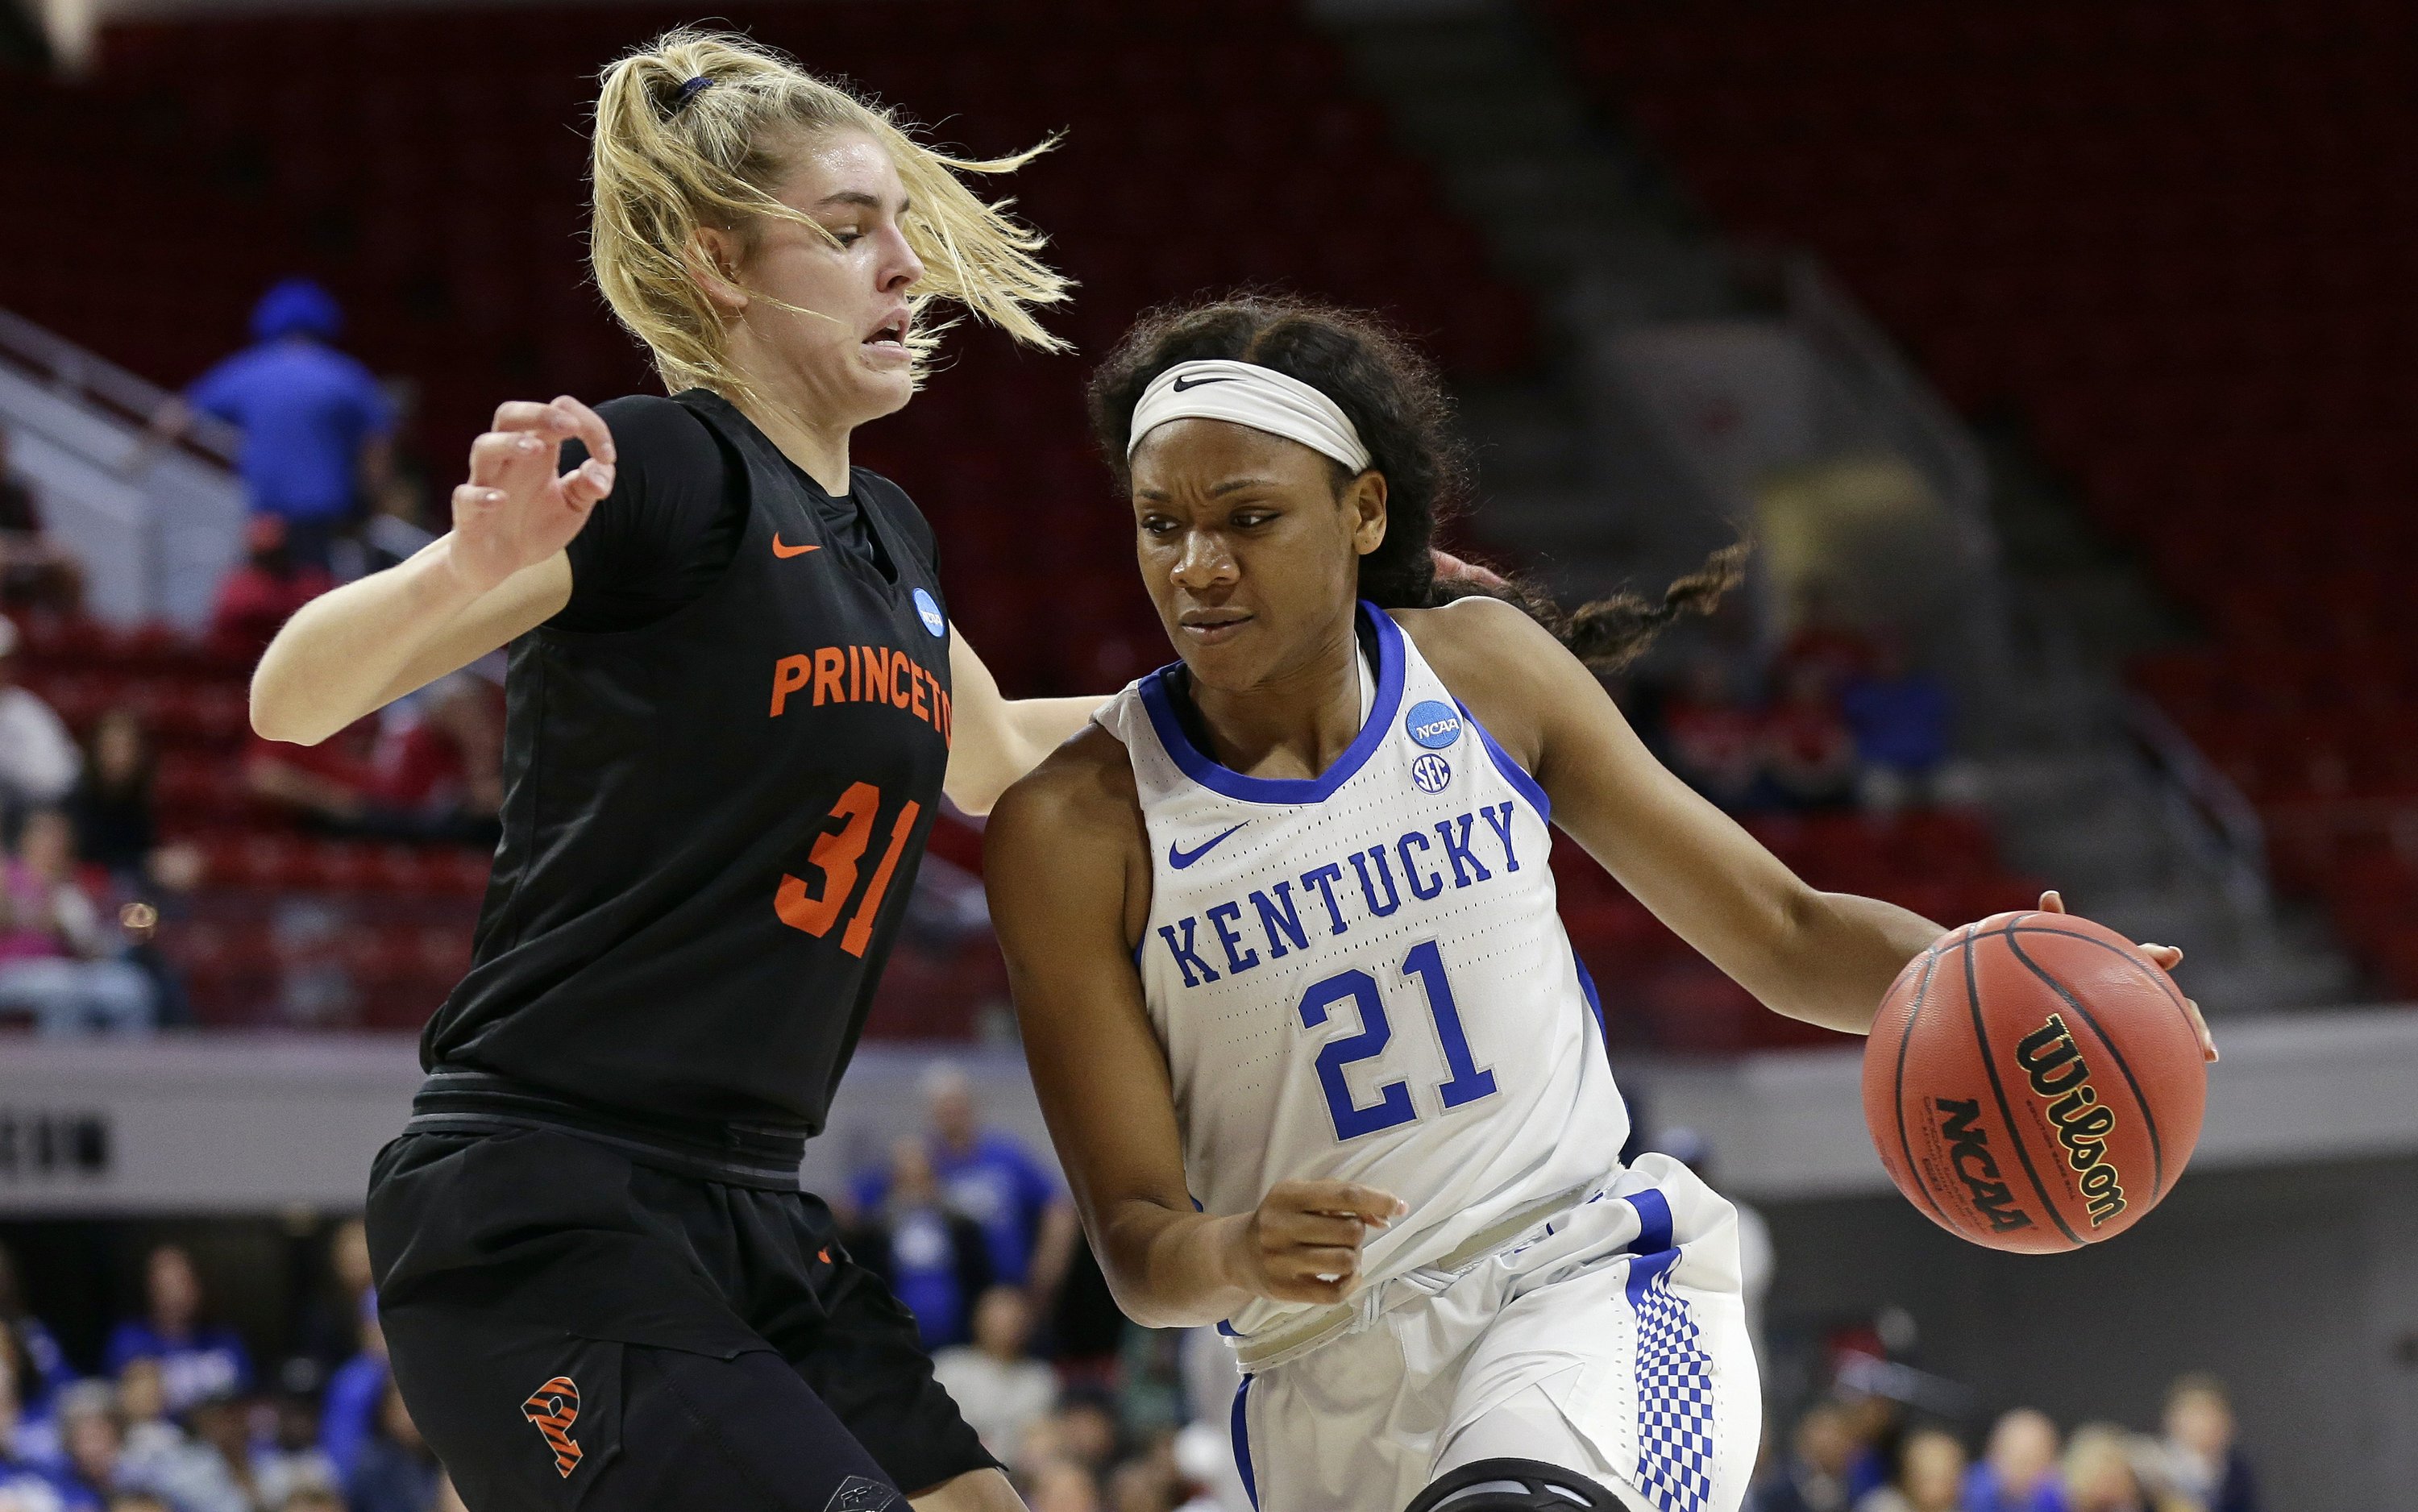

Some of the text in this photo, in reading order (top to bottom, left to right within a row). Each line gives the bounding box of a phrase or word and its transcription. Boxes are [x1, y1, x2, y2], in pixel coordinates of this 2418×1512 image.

[1413, 756, 1450, 791] SEC
[1416, 717, 1460, 740] NCAA
[773, 780, 920, 959] 31
[1158, 801, 1520, 988] KENTUCKY
[1296, 938, 1499, 1142] 21
[2015, 1012, 2127, 1227] Wilson
[1936, 1098, 2034, 1234] NCAA
